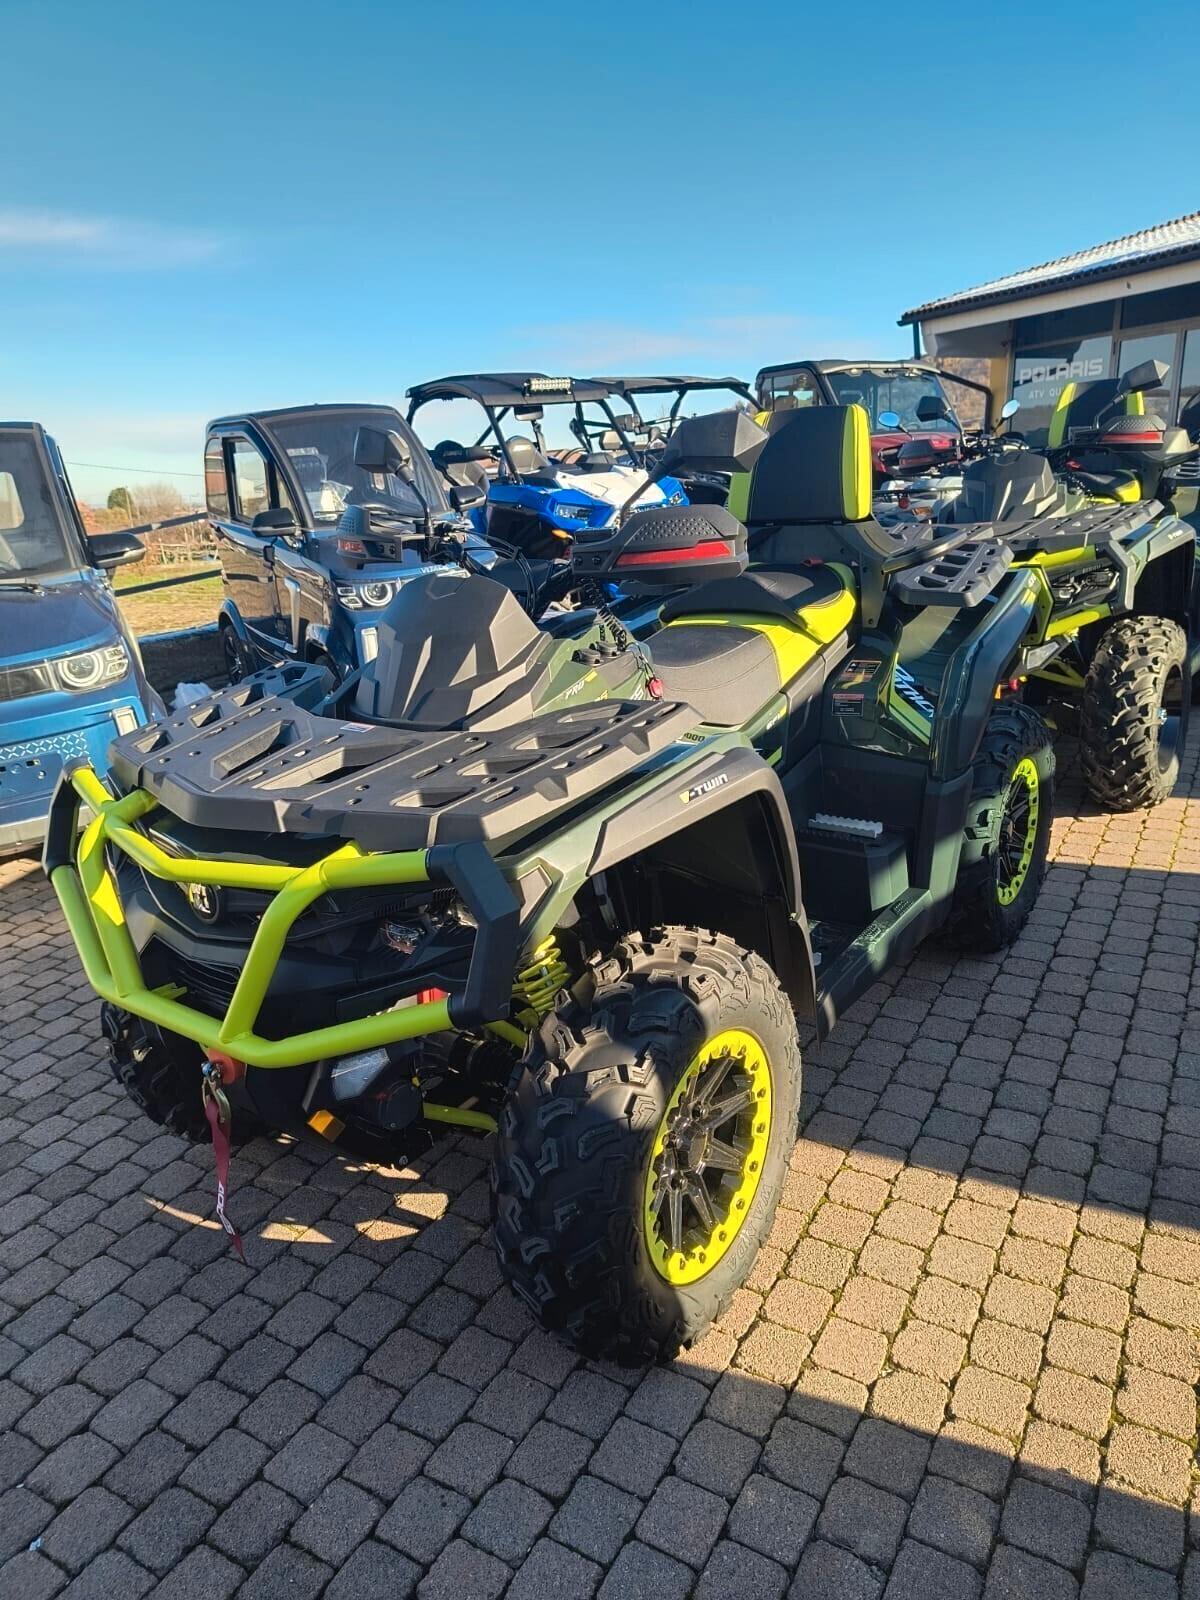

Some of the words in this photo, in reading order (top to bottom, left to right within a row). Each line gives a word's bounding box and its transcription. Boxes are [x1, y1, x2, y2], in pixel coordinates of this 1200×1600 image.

[1019, 358, 1103, 385] POLARIS
[1028, 389, 1045, 399] ATV
[1049, 387, 1062, 398] QU
